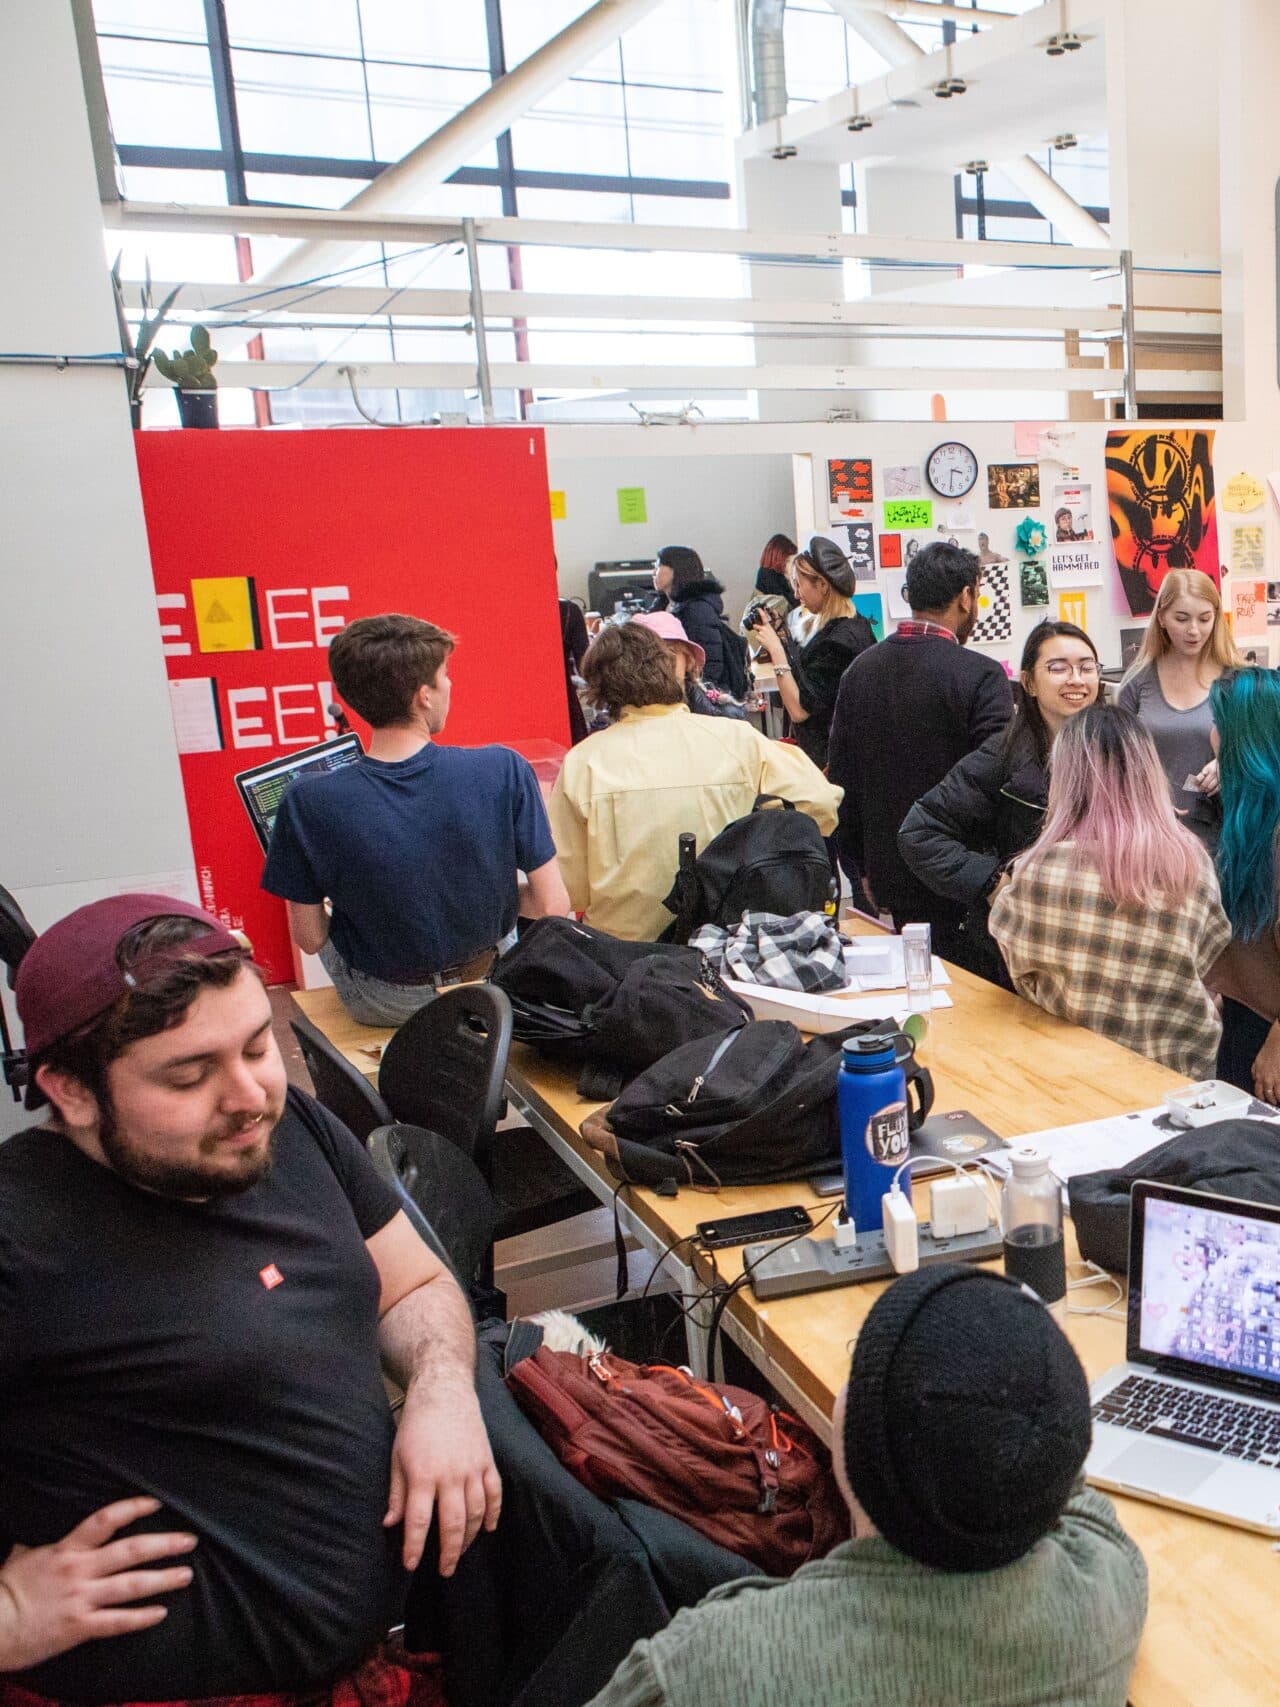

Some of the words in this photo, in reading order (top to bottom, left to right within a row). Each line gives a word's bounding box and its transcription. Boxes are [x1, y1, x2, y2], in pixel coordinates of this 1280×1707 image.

[1052, 554, 1073, 563] LET'S
[1075, 554, 1089, 563] GET
[1052, 561, 1100, 571] HAMMERED
[879, 1131, 908, 1156] YOU
